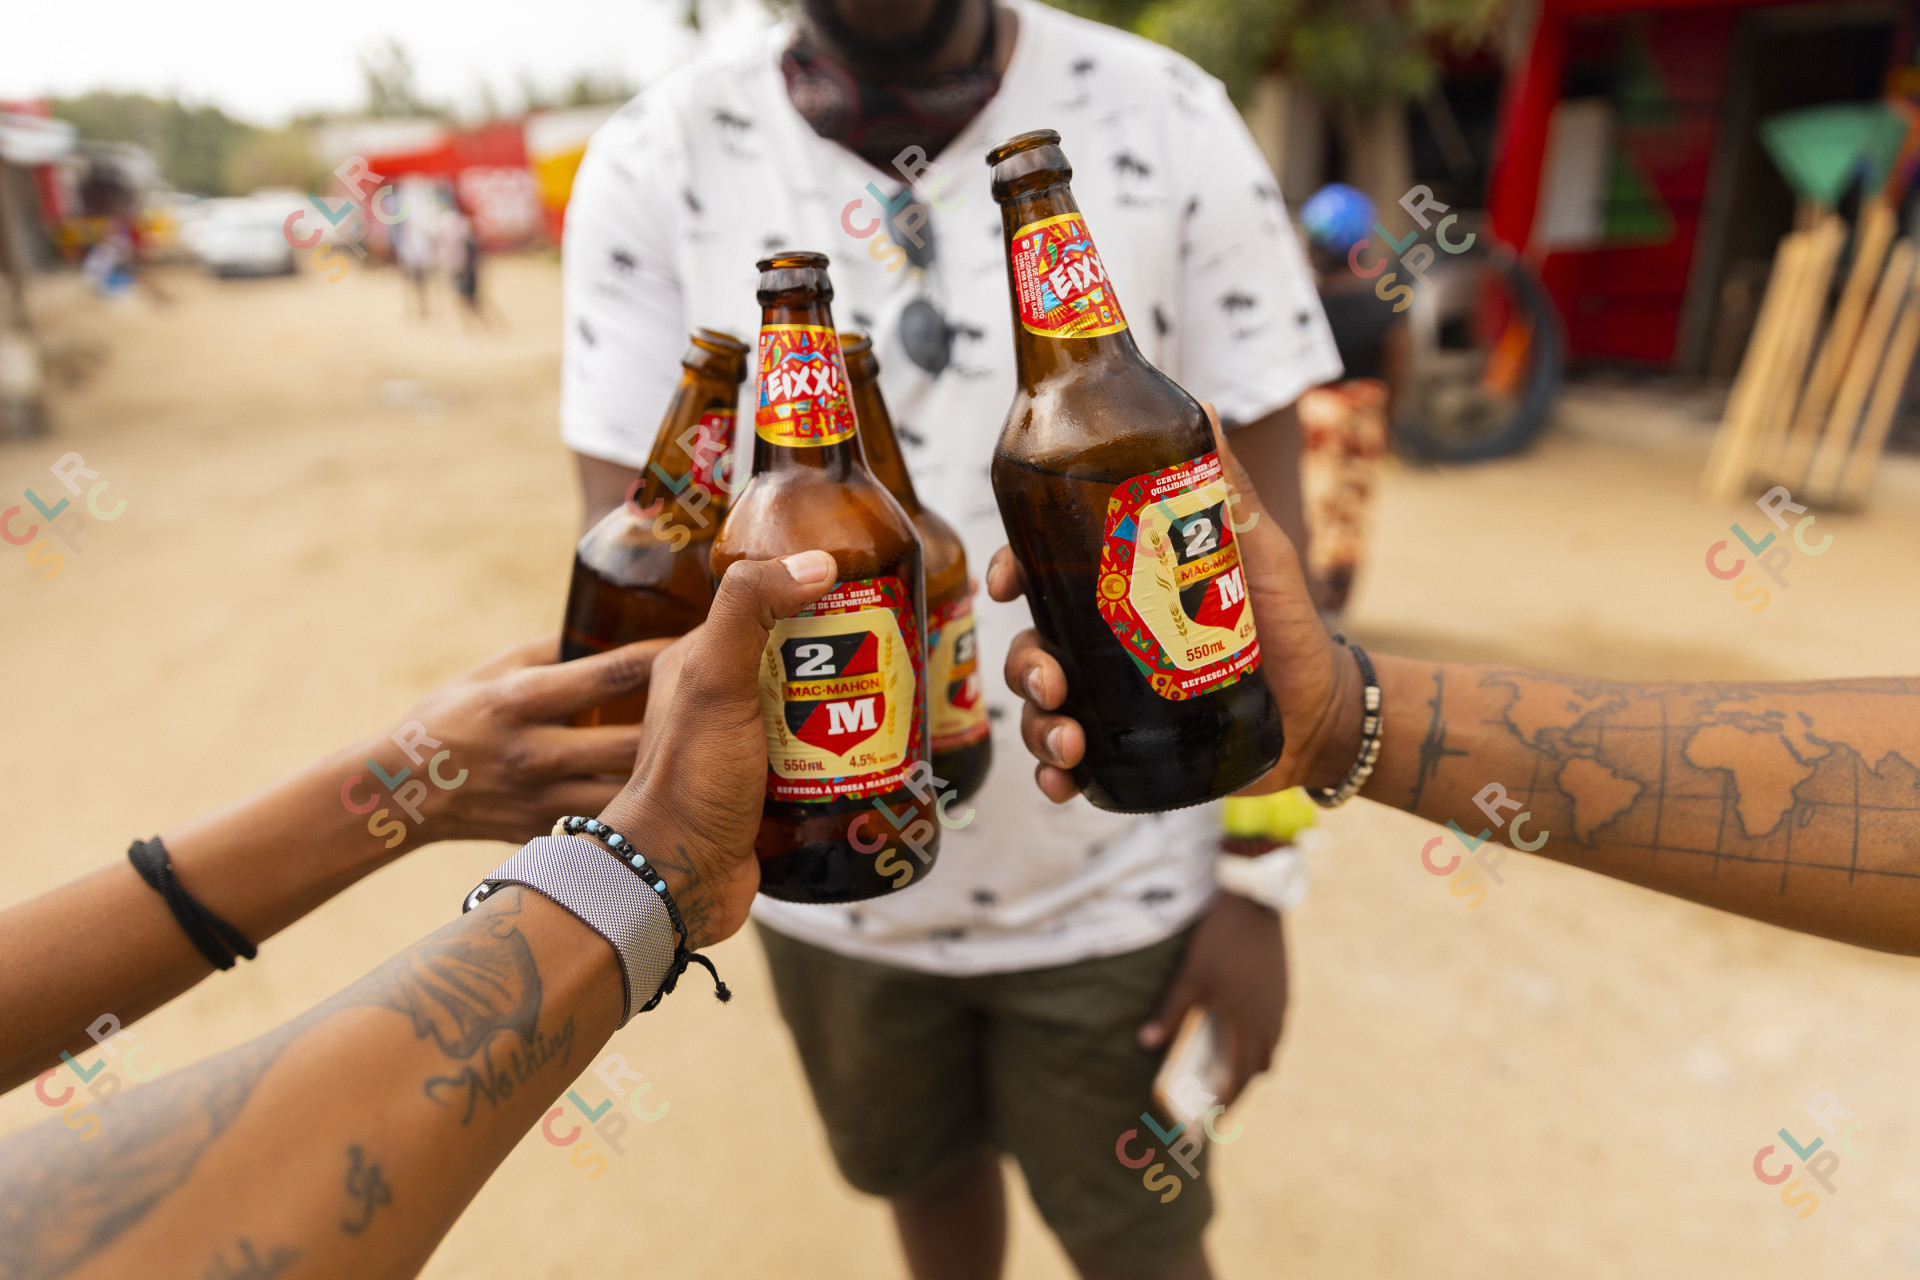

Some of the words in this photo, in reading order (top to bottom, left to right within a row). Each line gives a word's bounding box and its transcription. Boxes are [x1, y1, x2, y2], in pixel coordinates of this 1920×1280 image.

[1023, 251, 1029, 260] AO
[1029, 249, 1037, 269] LINHA
[1025, 260, 1035, 302] CONSUMIDOR
[1032, 269, 1039, 277] DE
[1033, 278, 1045, 319] ATENDIMENTO
[1150, 476, 1192, 496] QUALIDADE
[1156, 470, 1190, 486] CERVEJA
[1182, 518, 1217, 558] 2
[821, 592, 845, 602] BEER
[1216, 566, 1245, 611] M
[817, 602, 829, 610] DE
[830, 594, 882, 609] EXPORTAÇÃO
[795, 643, 836, 677] 2
[1181, 669, 1228, 689] REFRESCA
[825, 697, 878, 735] M
[849, 752, 877, 769] 4.5%
[776, 785, 823, 795] REFRESCA
[833, 782, 865, 794] NOSSA
[423, 1013, 575, 1127] Nothing
